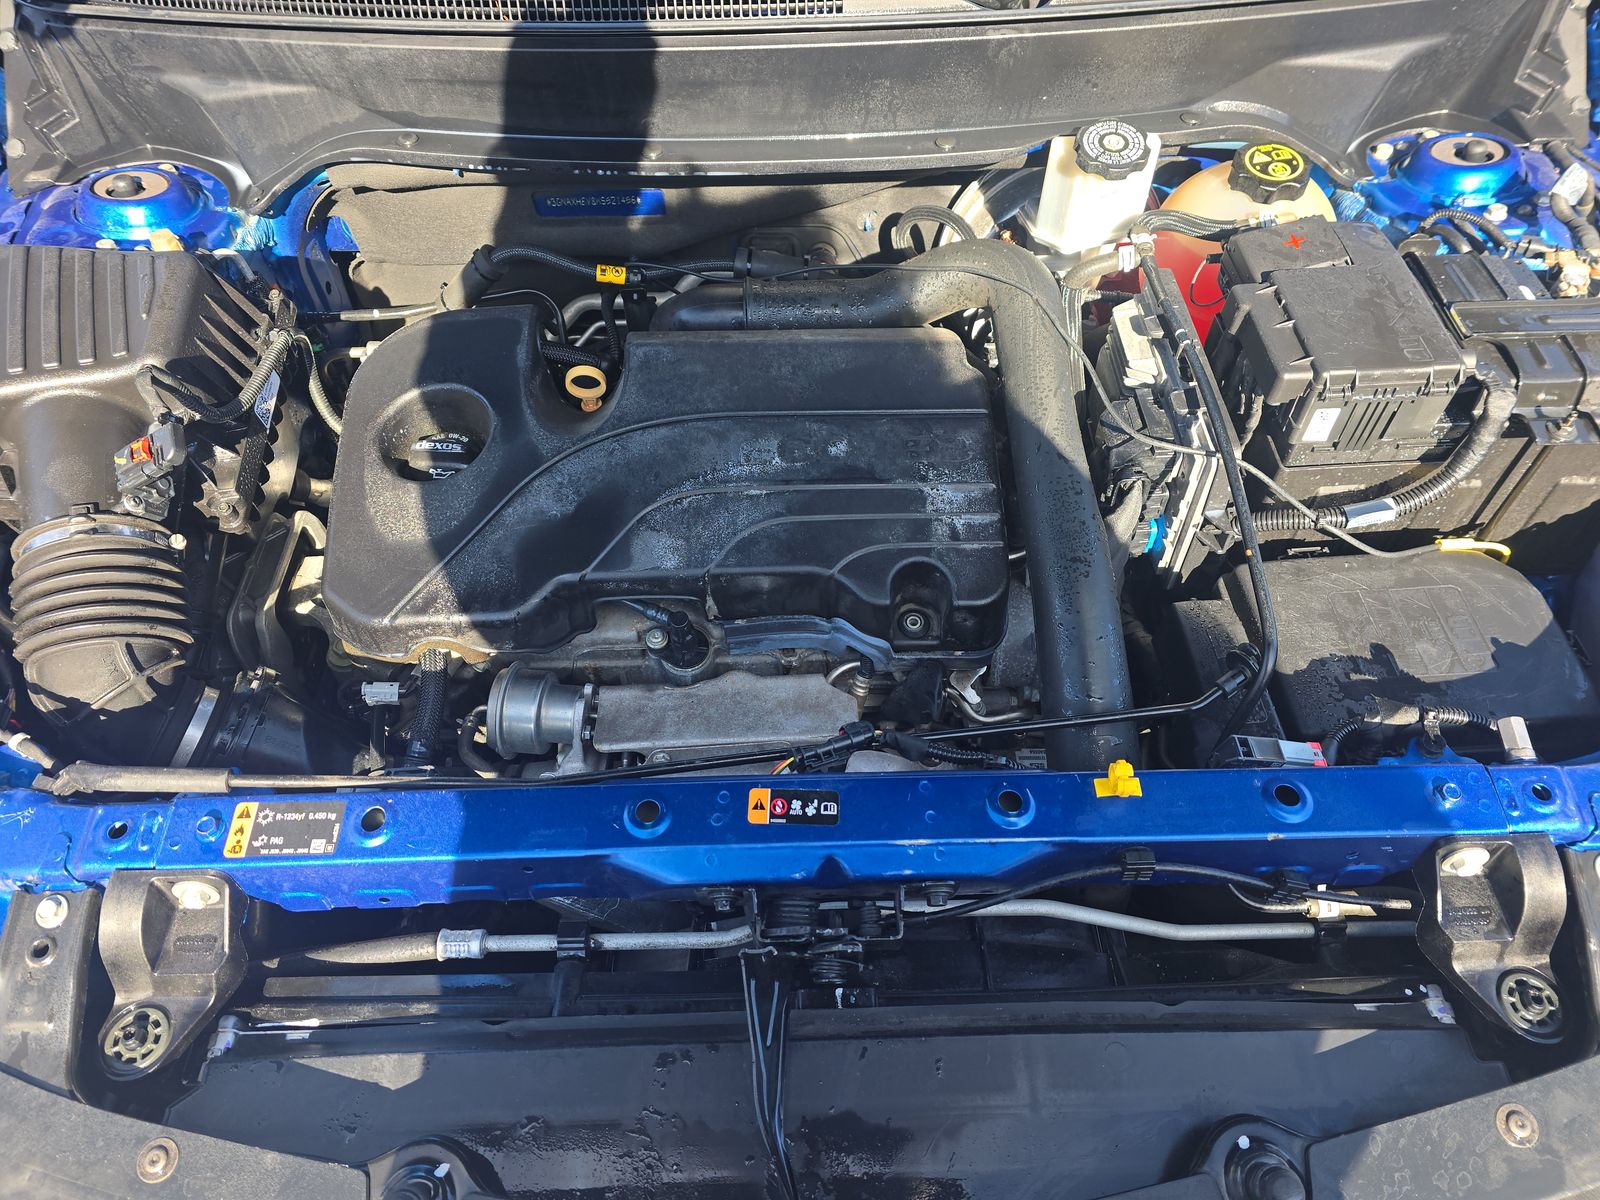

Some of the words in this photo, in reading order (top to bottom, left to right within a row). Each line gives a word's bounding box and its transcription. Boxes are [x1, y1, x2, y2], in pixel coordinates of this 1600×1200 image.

[448, 432, 469, 443] 0W-20
[415, 440, 462, 451] dexos
[275, 812, 306, 822] R-1234yf
[308, 811, 327, 820] 0.450
[327, 811, 337, 821] kg
[269, 836, 284, 845] PAG
